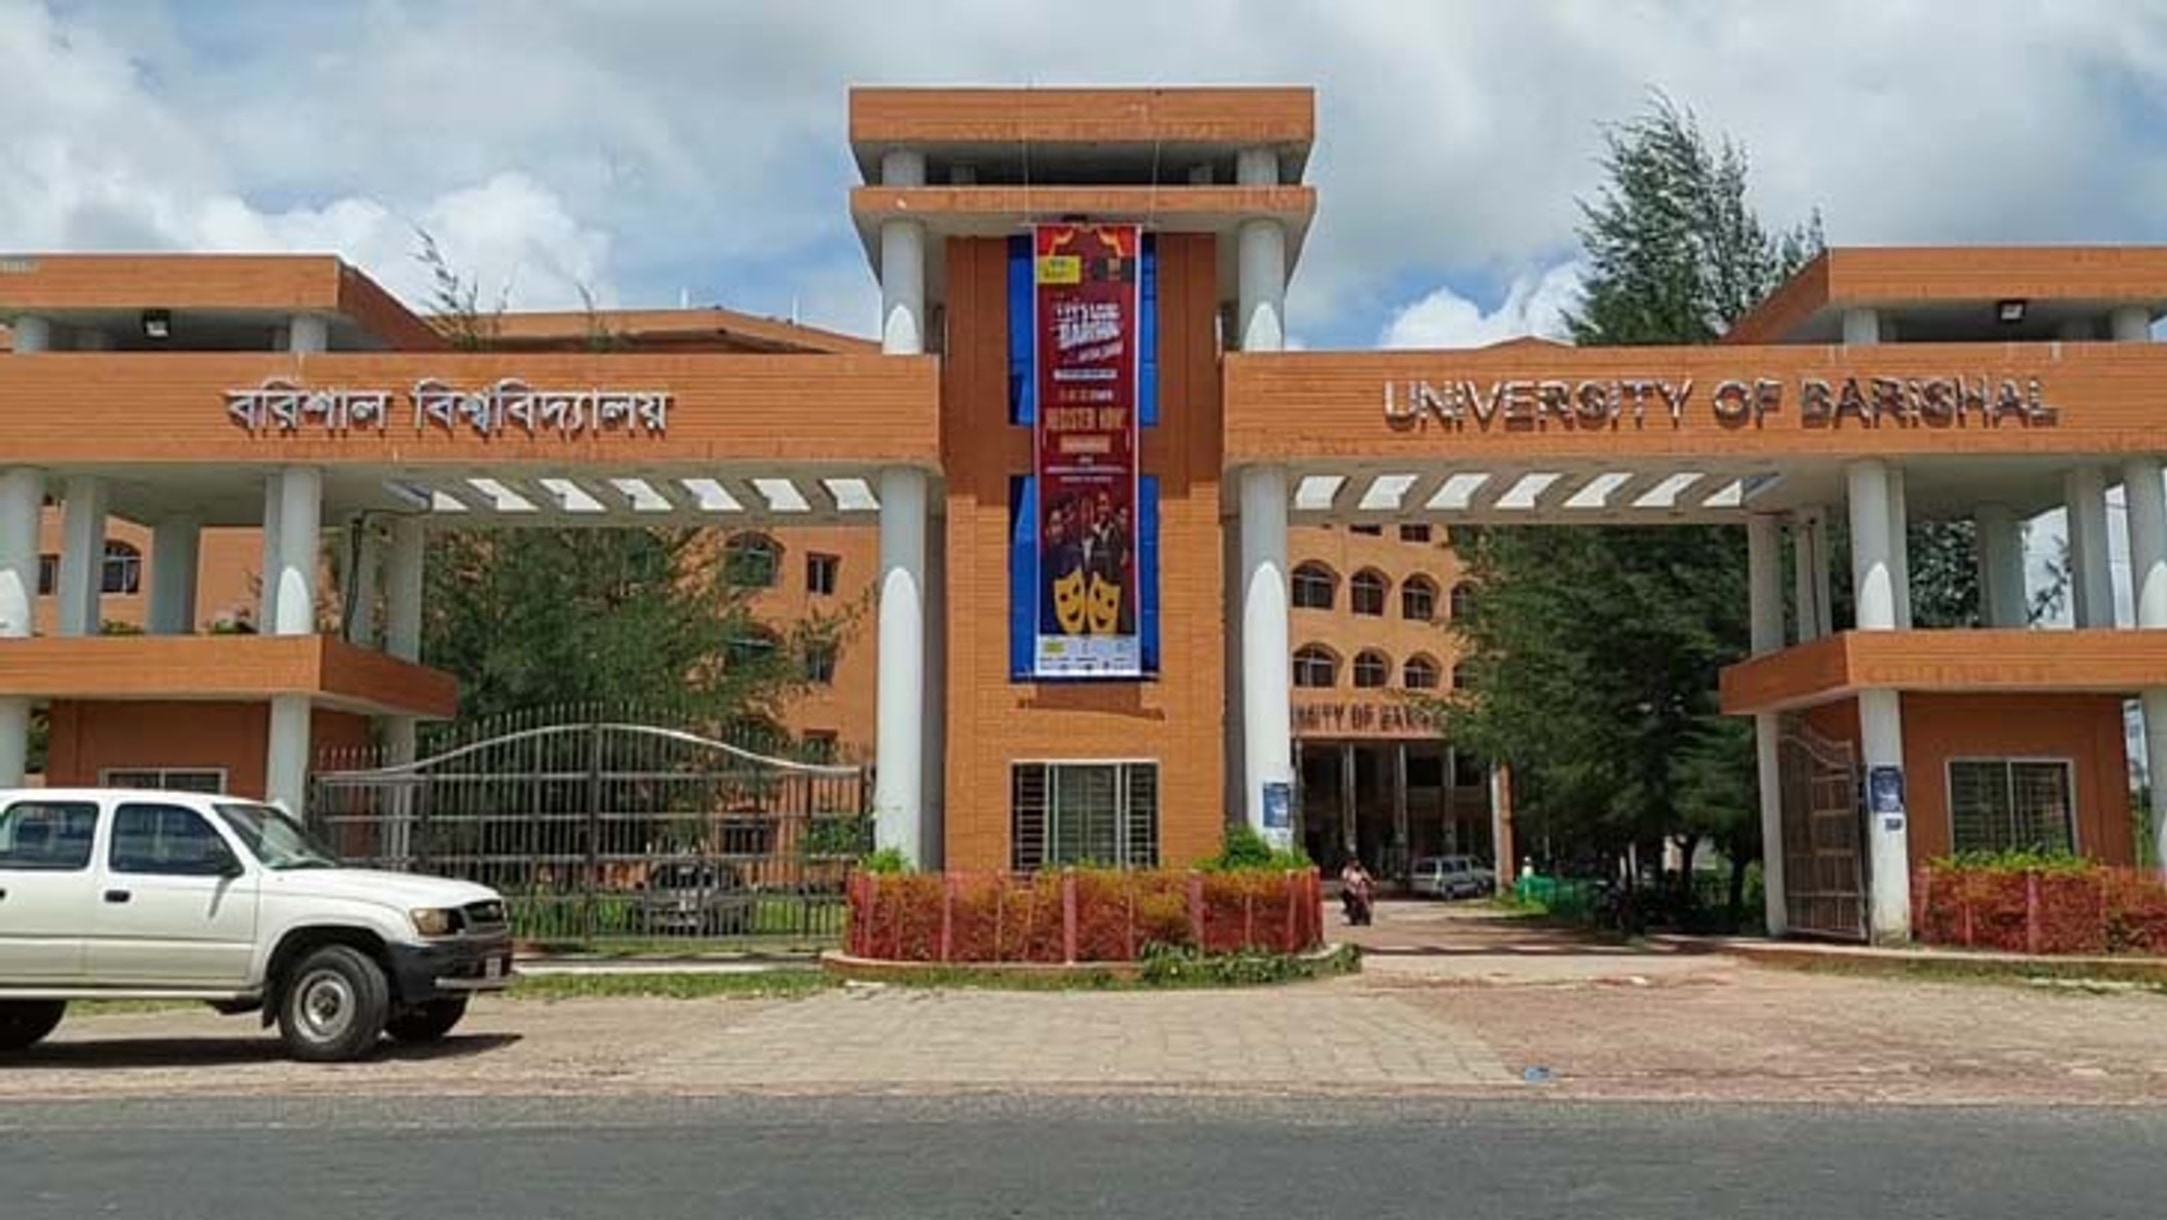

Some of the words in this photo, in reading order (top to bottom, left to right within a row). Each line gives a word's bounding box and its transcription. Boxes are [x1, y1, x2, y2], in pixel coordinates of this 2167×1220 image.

[223, 376, 393, 436] বরিশাল
[407, 376, 674, 441] বিশ্ববিদ্যালয়
[1384, 377, 1694, 432] UNIVERSITY
[1712, 378, 1783, 431] OF
[1800, 375, 2060, 430] BARISHAL
